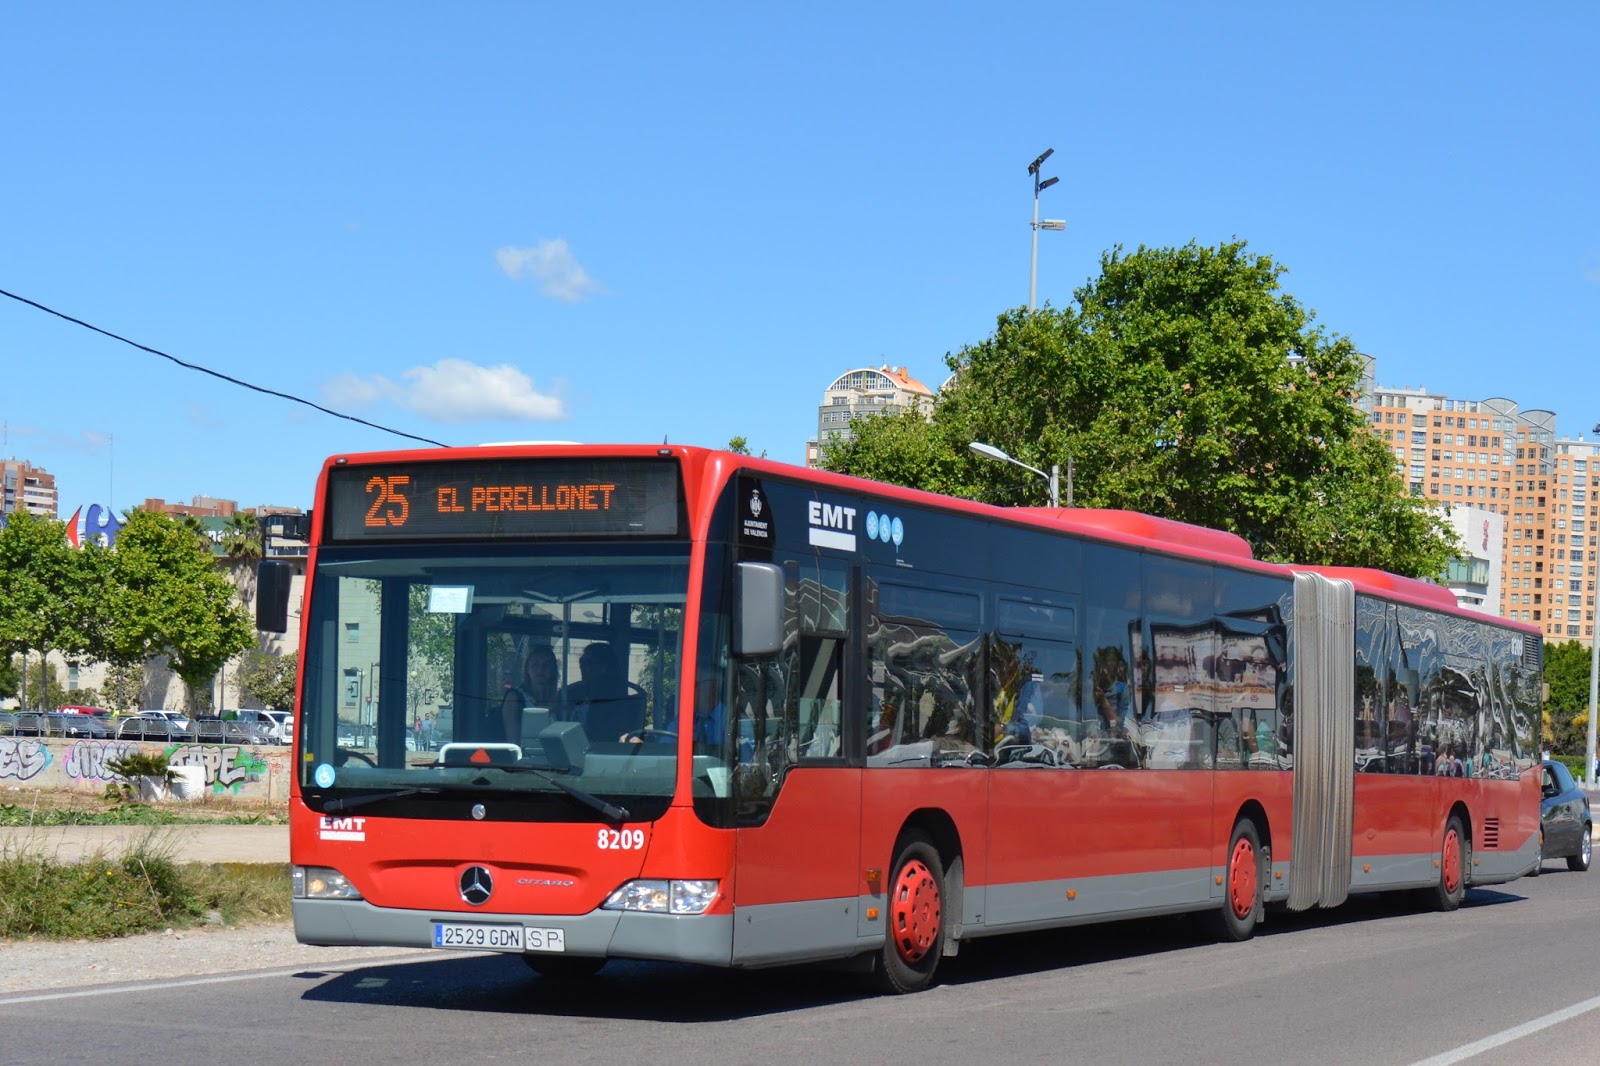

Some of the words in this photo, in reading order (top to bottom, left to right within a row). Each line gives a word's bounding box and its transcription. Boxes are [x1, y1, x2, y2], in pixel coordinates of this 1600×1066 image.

[365, 476, 410, 527] 25
[437, 487, 465, 513] EL
[471, 484, 616, 512] PERELLONET
[808, 500, 856, 531] EMT
[319, 816, 366, 831] EMT
[597, 829, 644, 849] 8209
[516, 877, 574, 887] CITARO
[445, 927, 485, 945] 2529
[489, 929, 520, 947] GDN
[530, 930, 559, 948] SP
